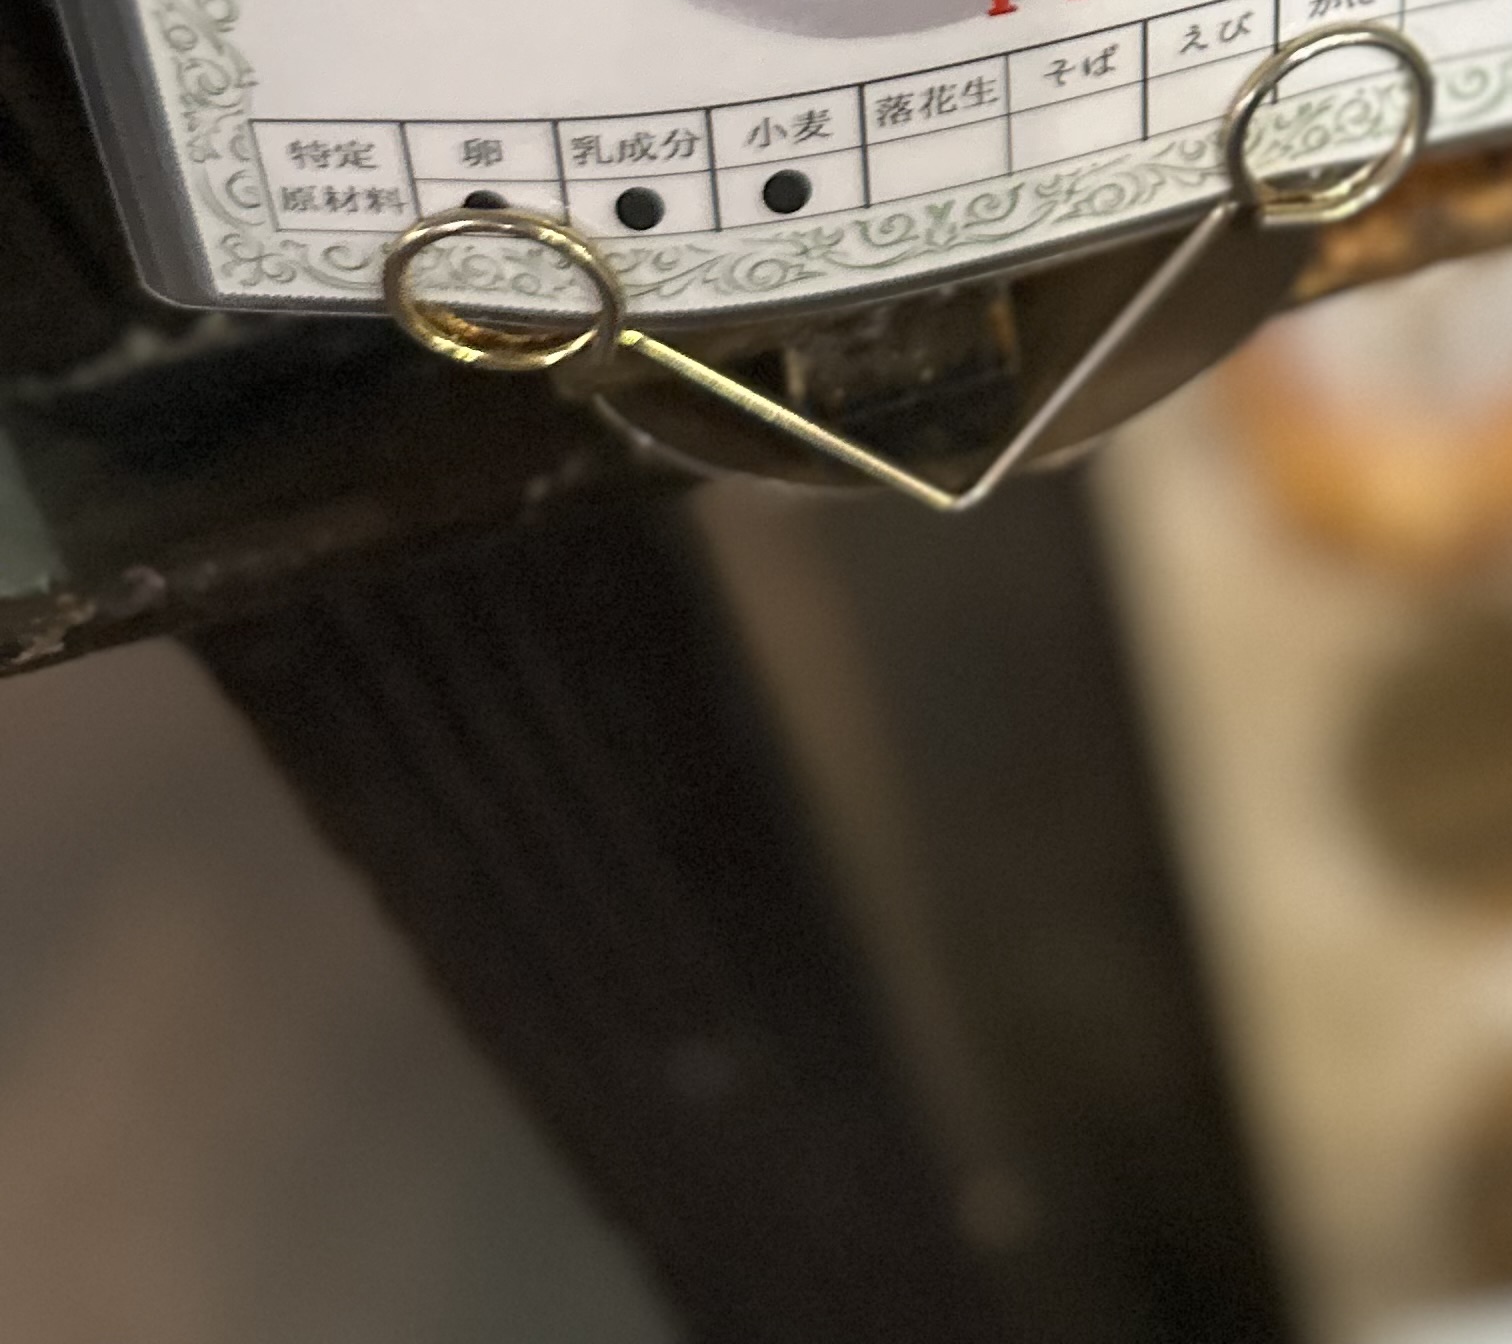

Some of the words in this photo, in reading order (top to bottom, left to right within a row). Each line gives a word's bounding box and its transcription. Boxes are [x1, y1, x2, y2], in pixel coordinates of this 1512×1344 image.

[285, 138, 379, 169] 特定
[459, 137, 502, 167] 卵
[570, 129, 700, 169] 乳成分
[746, 108, 832, 150] 小麦
[874, 75, 998, 127] 落花生
[1043, 44, 1117, 87] そば
[1179, 14, 1252, 56] えび
[281, 184, 404, 216] 原材料
